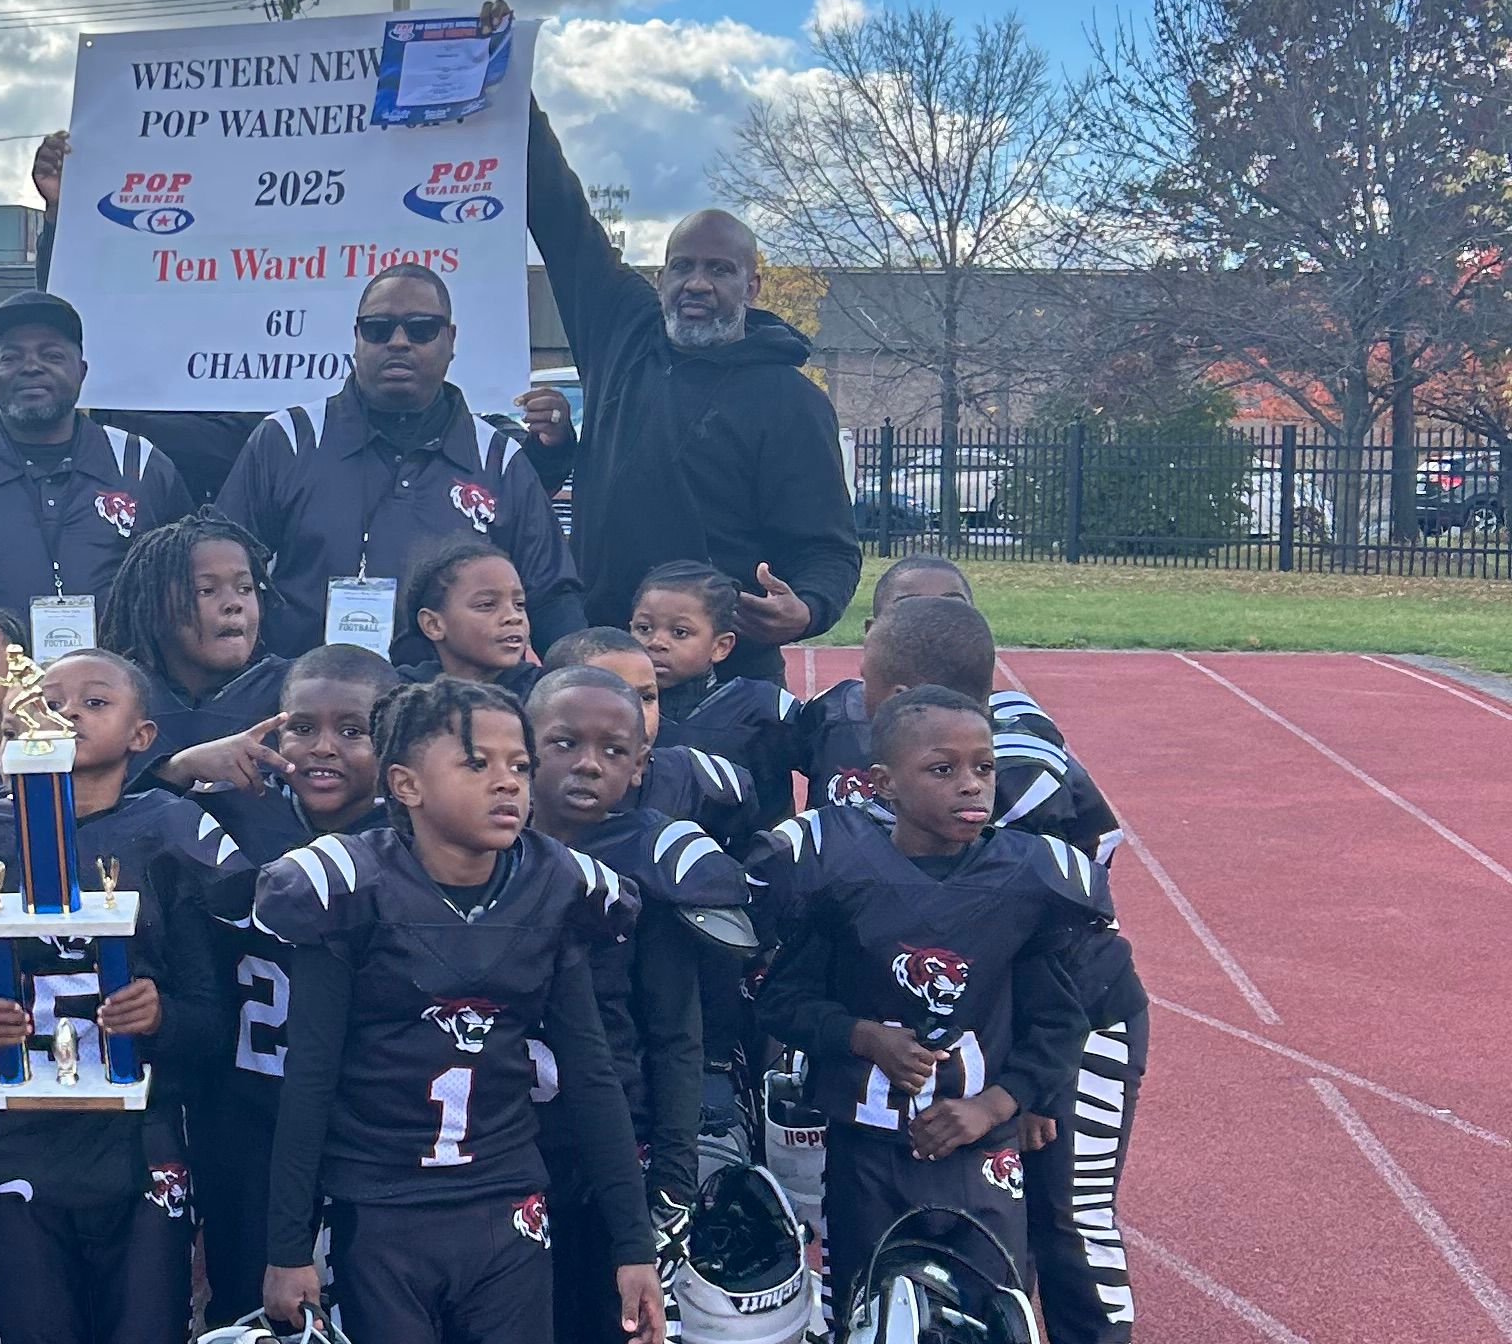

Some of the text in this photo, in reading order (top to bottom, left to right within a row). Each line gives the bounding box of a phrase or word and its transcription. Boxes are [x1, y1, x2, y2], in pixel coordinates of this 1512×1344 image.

[131, 53, 301, 91] WESTERN
[308, 46, 383, 83] NEW
[138, 109, 210, 138] POP
[218, 103, 368, 138] WARNER
[120, 172, 193, 193] POP
[426, 157, 499, 184] POP
[118, 194, 185, 204] WARNER
[254, 168, 346, 207] 2025
[425, 181, 493, 196] WARNER
[152, 249, 217, 283] Ten
[230, 245, 328, 281] Ward
[265, 308, 307, 338] 6U
[338, 622, 380, 633] FOOTBALL
[43, 639, 84, 648] FOOTBALL
[420, 1066, 474, 1168] 1
